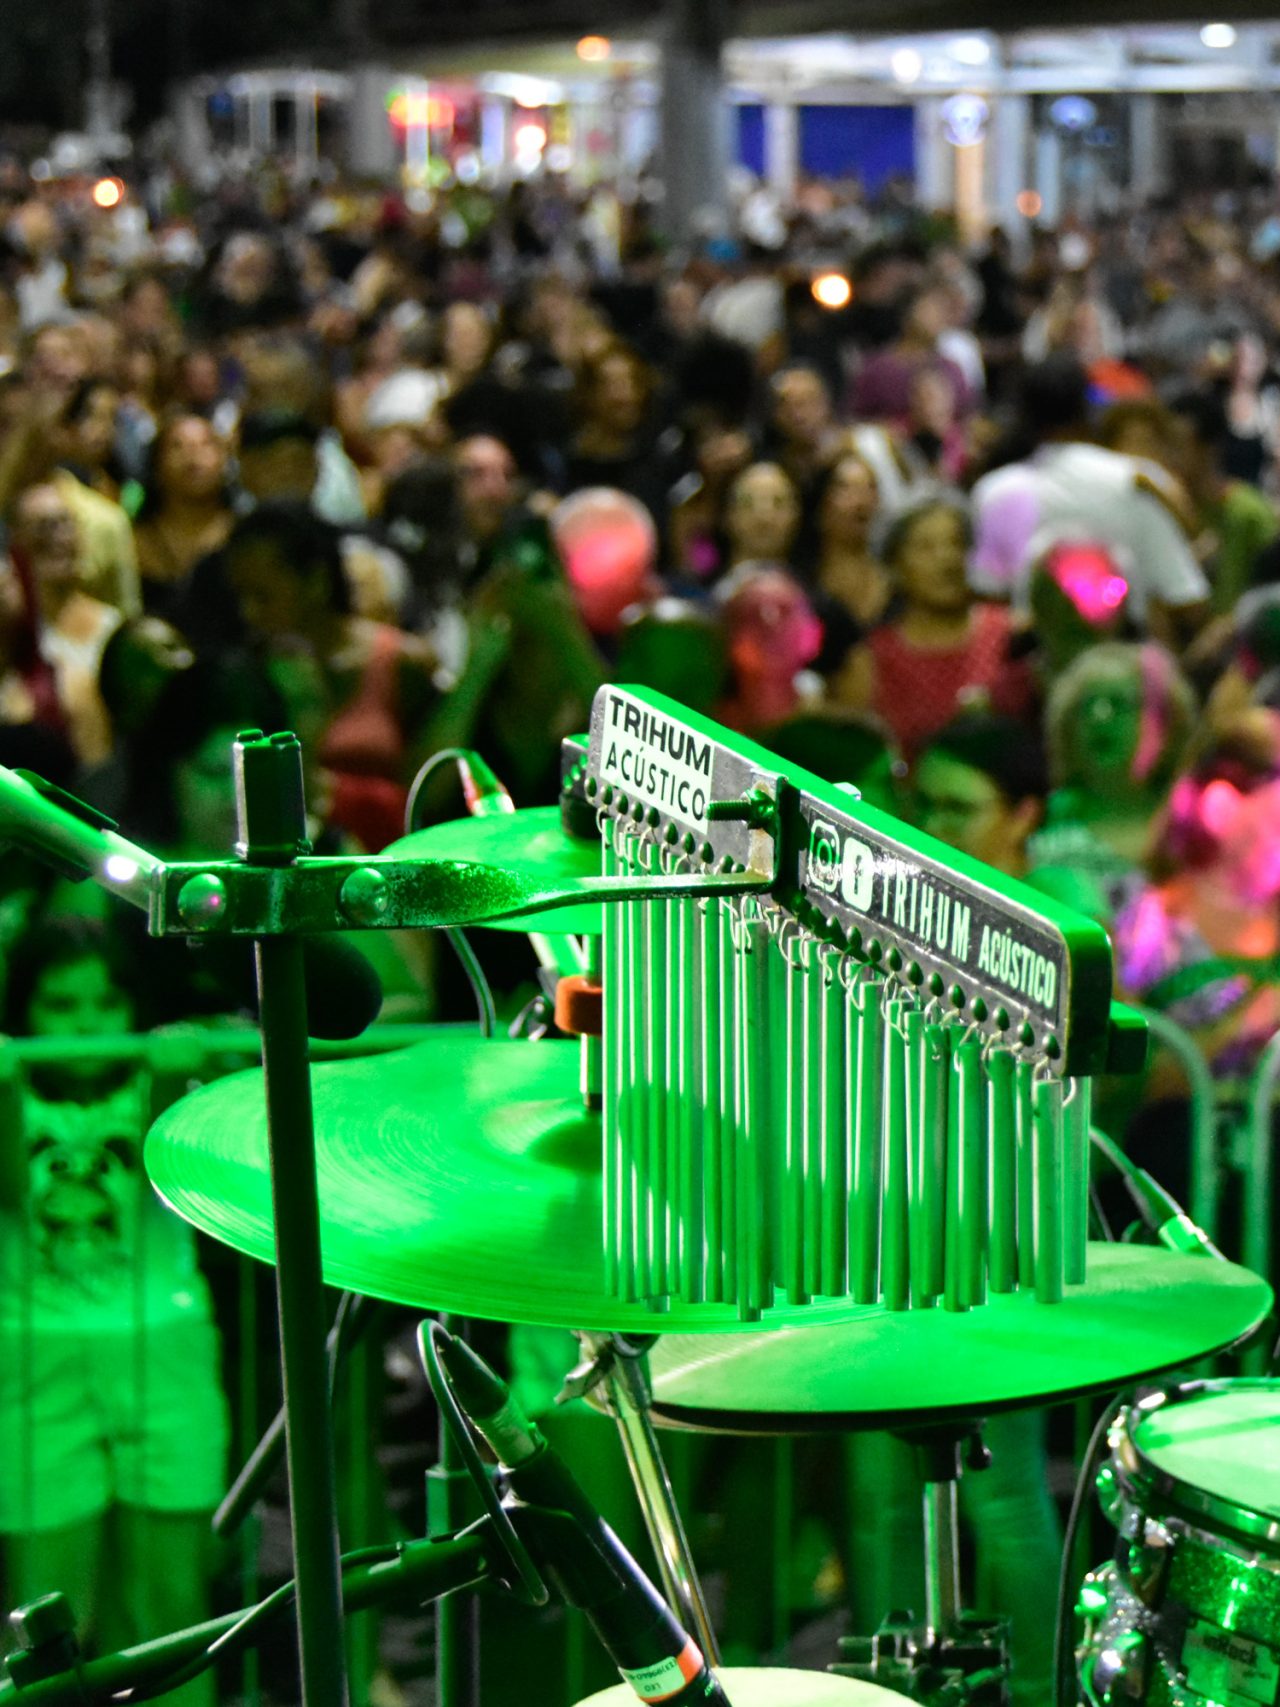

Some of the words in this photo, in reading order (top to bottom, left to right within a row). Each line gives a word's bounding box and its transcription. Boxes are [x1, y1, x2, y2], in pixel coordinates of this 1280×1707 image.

[610, 694, 711, 776] TRIHUM
[605, 741, 706, 821] ACÚSTICO
[879, 864, 971, 963] TRIHUM
[978, 924, 1056, 1009] ACÚSTICO
